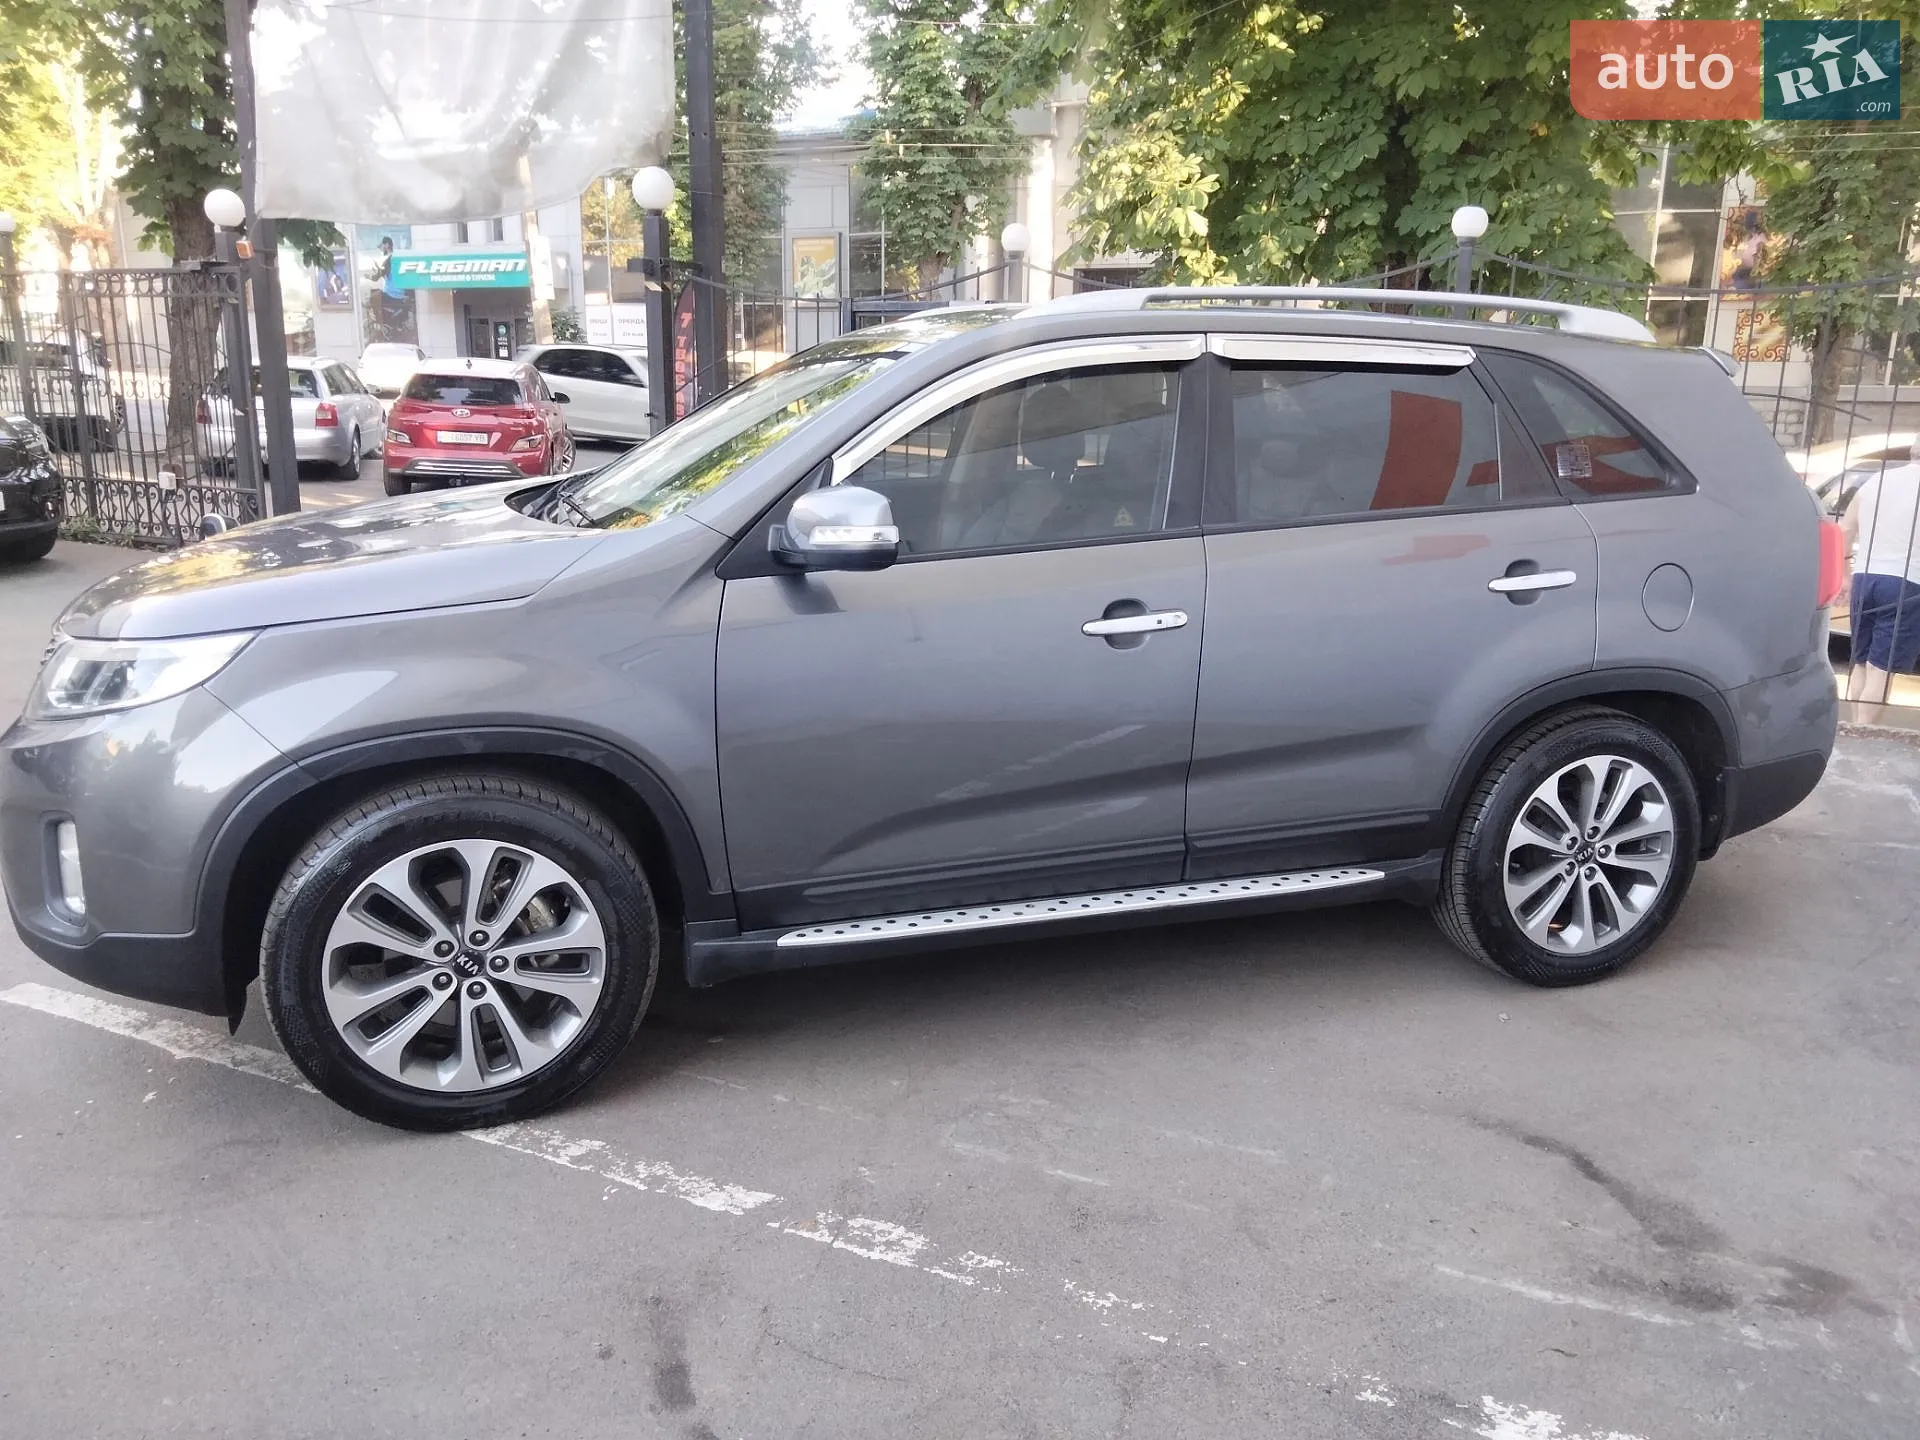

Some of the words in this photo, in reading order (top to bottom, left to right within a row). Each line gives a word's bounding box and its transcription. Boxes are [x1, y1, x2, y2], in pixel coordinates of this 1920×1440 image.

[398, 258, 527, 274] FLAGMAN
[1577, 847, 1593, 861] KIA
[456, 954, 479, 975] KIA
